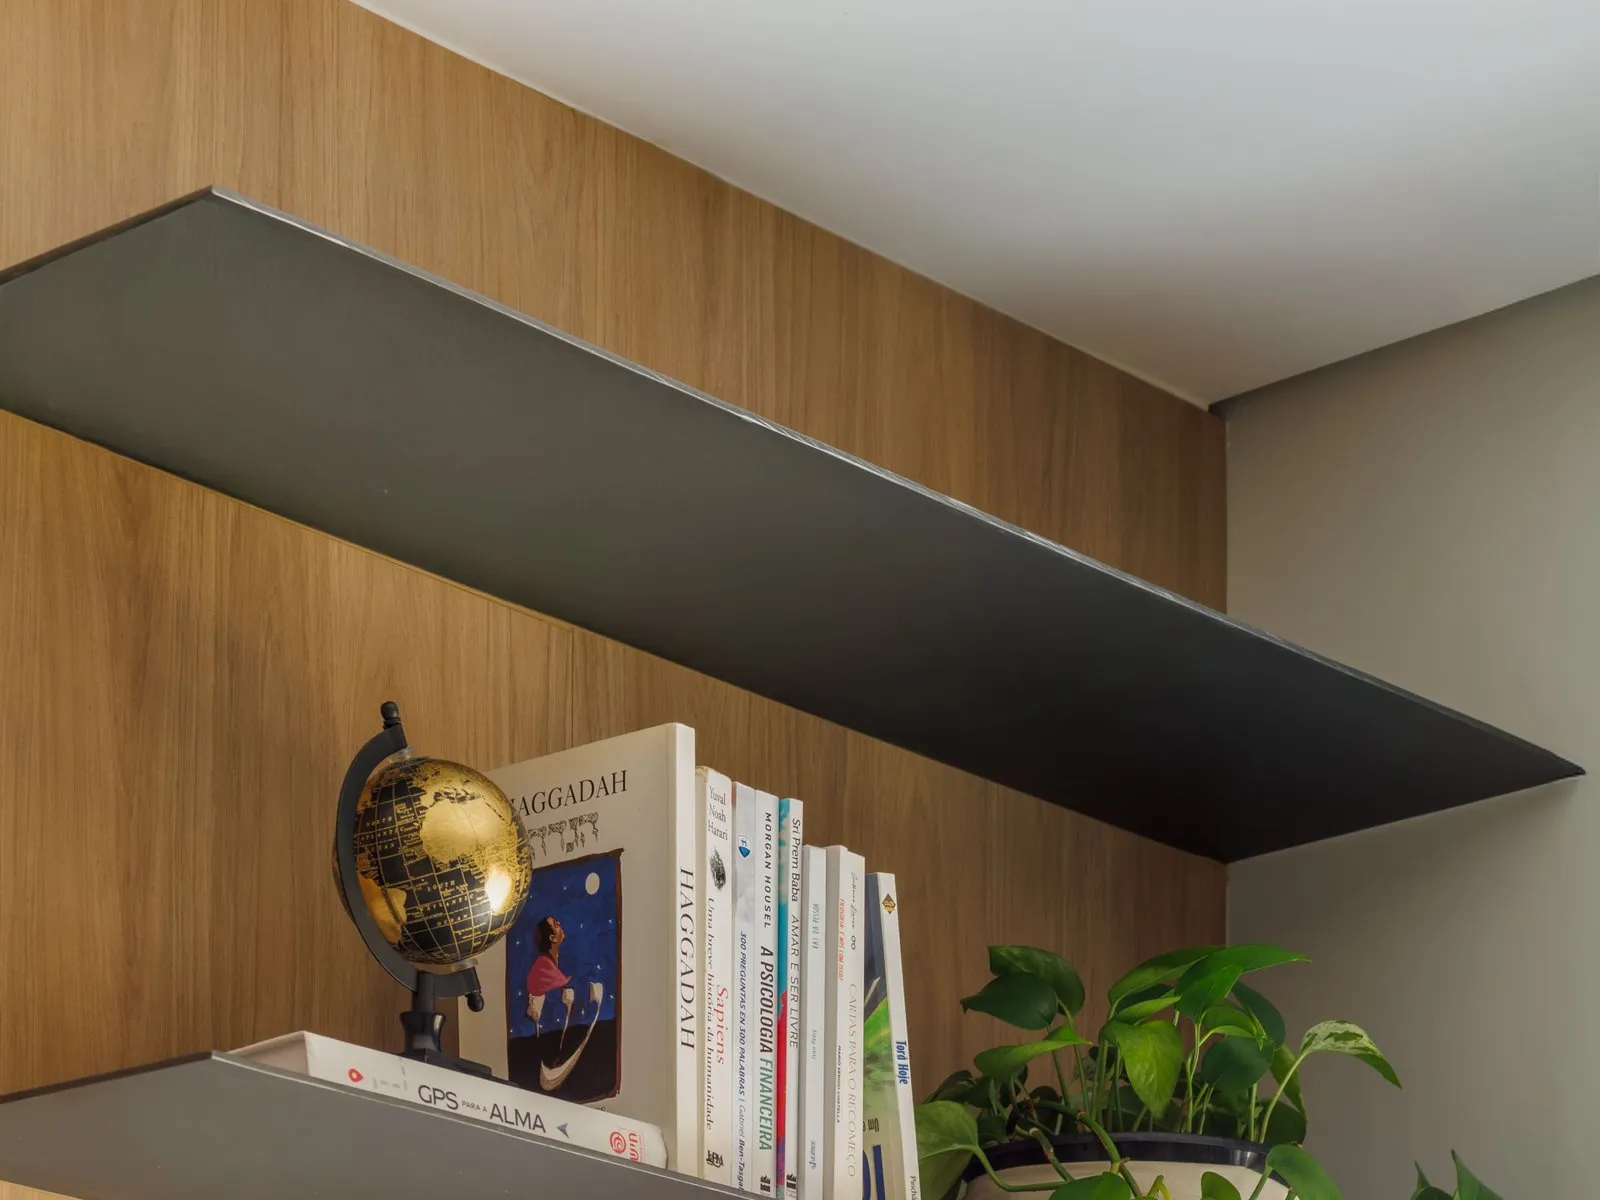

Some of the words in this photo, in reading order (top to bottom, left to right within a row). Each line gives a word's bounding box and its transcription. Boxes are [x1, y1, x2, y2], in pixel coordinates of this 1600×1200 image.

[511, 769, 627, 817] AGGADAH
[709, 785, 726, 806] Yuval
[709, 803, 727, 823] Noah
[792, 818, 801, 834] Sri
[708, 820, 729, 841] Harari
[764, 812, 772, 870] MORGAN
[791, 836, 801, 869] Prem
[764, 875, 772, 929] HOUSEL
[791, 873, 801, 902] Baba
[707, 897, 715, 929] Uma
[707, 933, 715, 969] breve
[740, 931, 748, 951] 300
[760, 945, 774, 957] A
[790, 915, 800, 958] AMAR
[680, 868, 695, 1049] HAGGADAH
[790, 962, 799, 971] E
[707, 973, 715, 1022] história
[739, 952, 747, 1011] PREGUNTAS
[789, 976, 799, 1003] SER
[739, 1013, 746, 1025] EN
[760, 961, 774, 1053] PSICOLOGIA
[848, 983, 857, 1038] CARTAS
[707, 1025, 715, 1043] da
[713, 984, 729, 1065] Sapiens
[739, 1027, 747, 1045] 300
[789, 1008, 799, 1050] LIVRE
[848, 1040, 857, 1073] PARA
[895, 1040, 908, 1061] Torá
[738, 1047, 746, 1096] PALABRAS
[847, 1077, 857, 1089] O
[897, 1063, 910, 1085] Hoje
[706, 1046, 715, 1131] humanidade
[759, 1058, 774, 1151] FINANCEIRA
[418, 1084, 459, 1111] GPS
[461, 1100, 481, 1112] PARA
[489, 1103, 547, 1133] ALMA
[846, 1093, 857, 1178] RECOMEÇO
